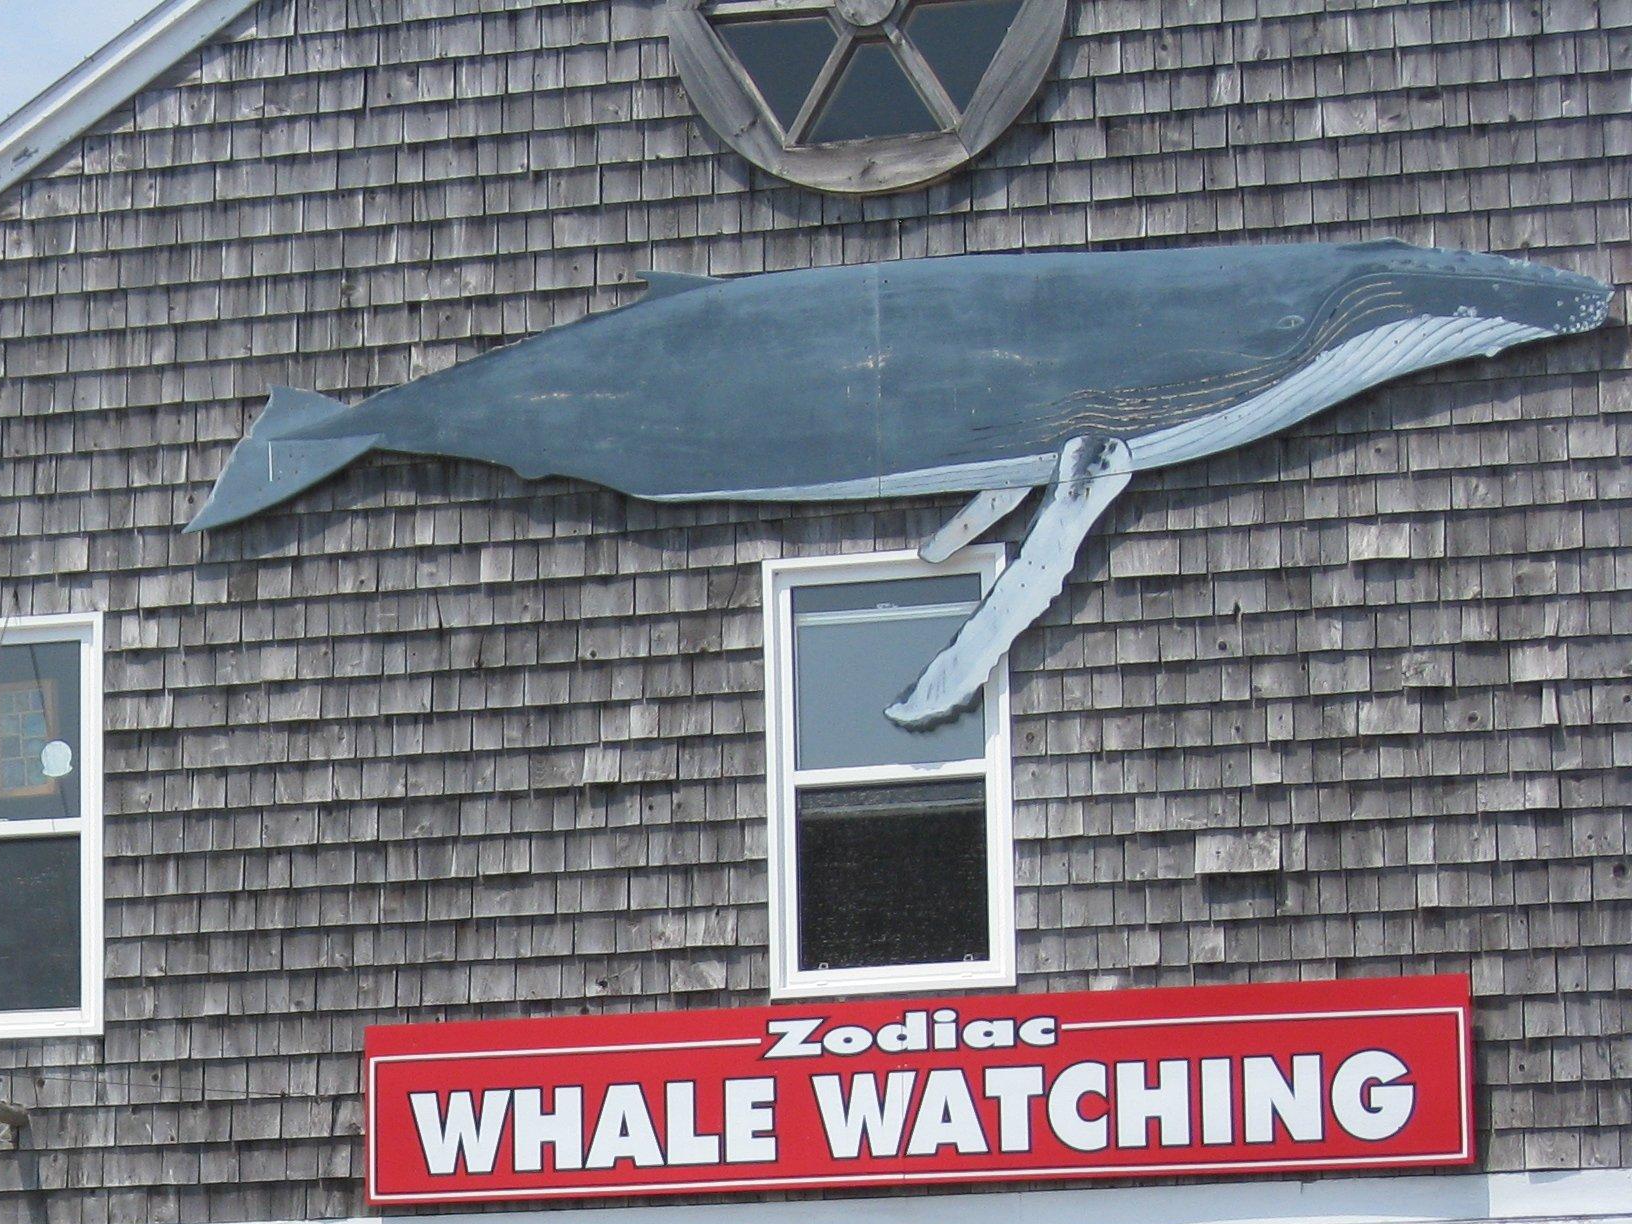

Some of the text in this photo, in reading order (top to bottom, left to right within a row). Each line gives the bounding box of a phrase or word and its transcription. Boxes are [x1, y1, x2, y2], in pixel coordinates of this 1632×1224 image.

[763, 1007, 1057, 1059] Zodiac
[409, 1048, 1415, 1175] WHALE WATCHING
